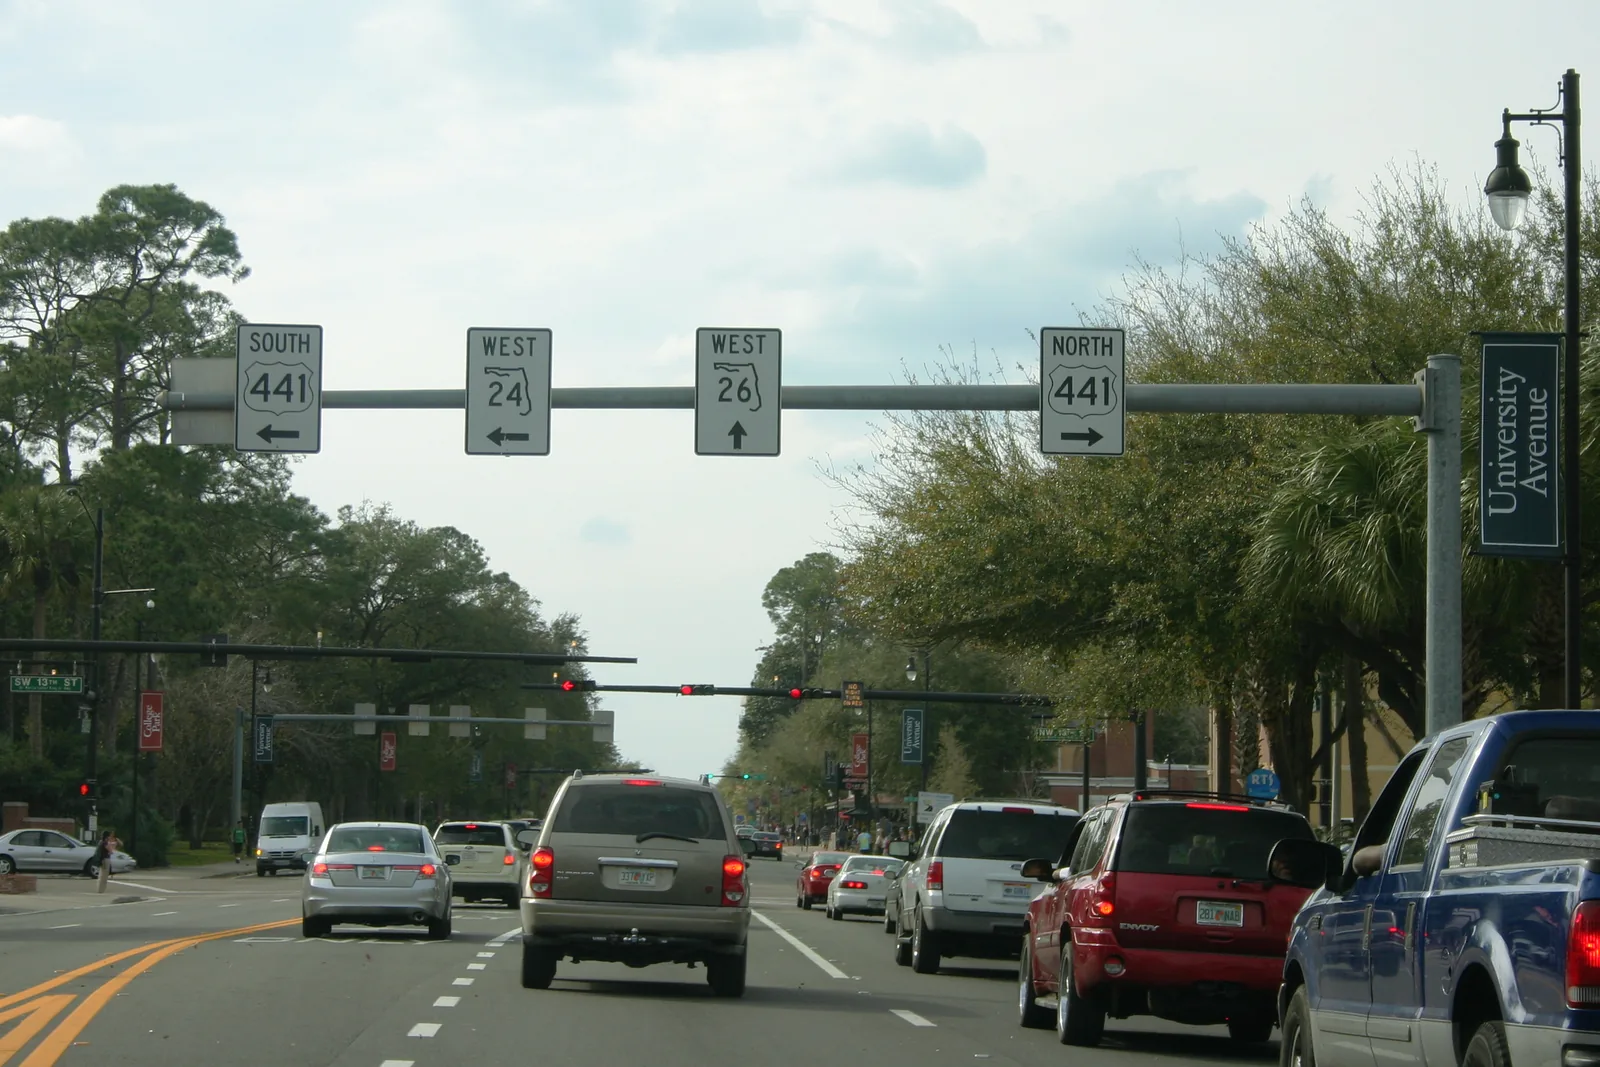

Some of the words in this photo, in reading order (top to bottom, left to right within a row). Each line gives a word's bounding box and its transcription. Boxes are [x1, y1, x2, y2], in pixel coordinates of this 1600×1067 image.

[249, 332, 310, 354] SOUTH
[482, 336, 537, 357] WEST
[711, 334, 767, 355] WEST
[1052, 335, 1113, 357] NORTH
[250, 373, 307, 405] 441
[488, 380, 523, 407] 24
[718, 376, 752, 403] 26
[1053, 375, 1110, 406] 441
[1488, 366, 1527, 517] University
[1519, 387, 1548, 498] Avenue
[14, 677, 31, 687] SW
[63, 678, 78, 687] ST
[143, 704, 153, 738] College
[151, 711, 161, 732] Park
[903, 715, 916, 754] University
[912, 720, 921, 749] Avenue
[1039, 728, 1054, 737] NW
[1251, 774, 1274, 787] RTS
[1199, 908, 1214, 920] 281
[1119, 922, 1160, 931] ENVOY
